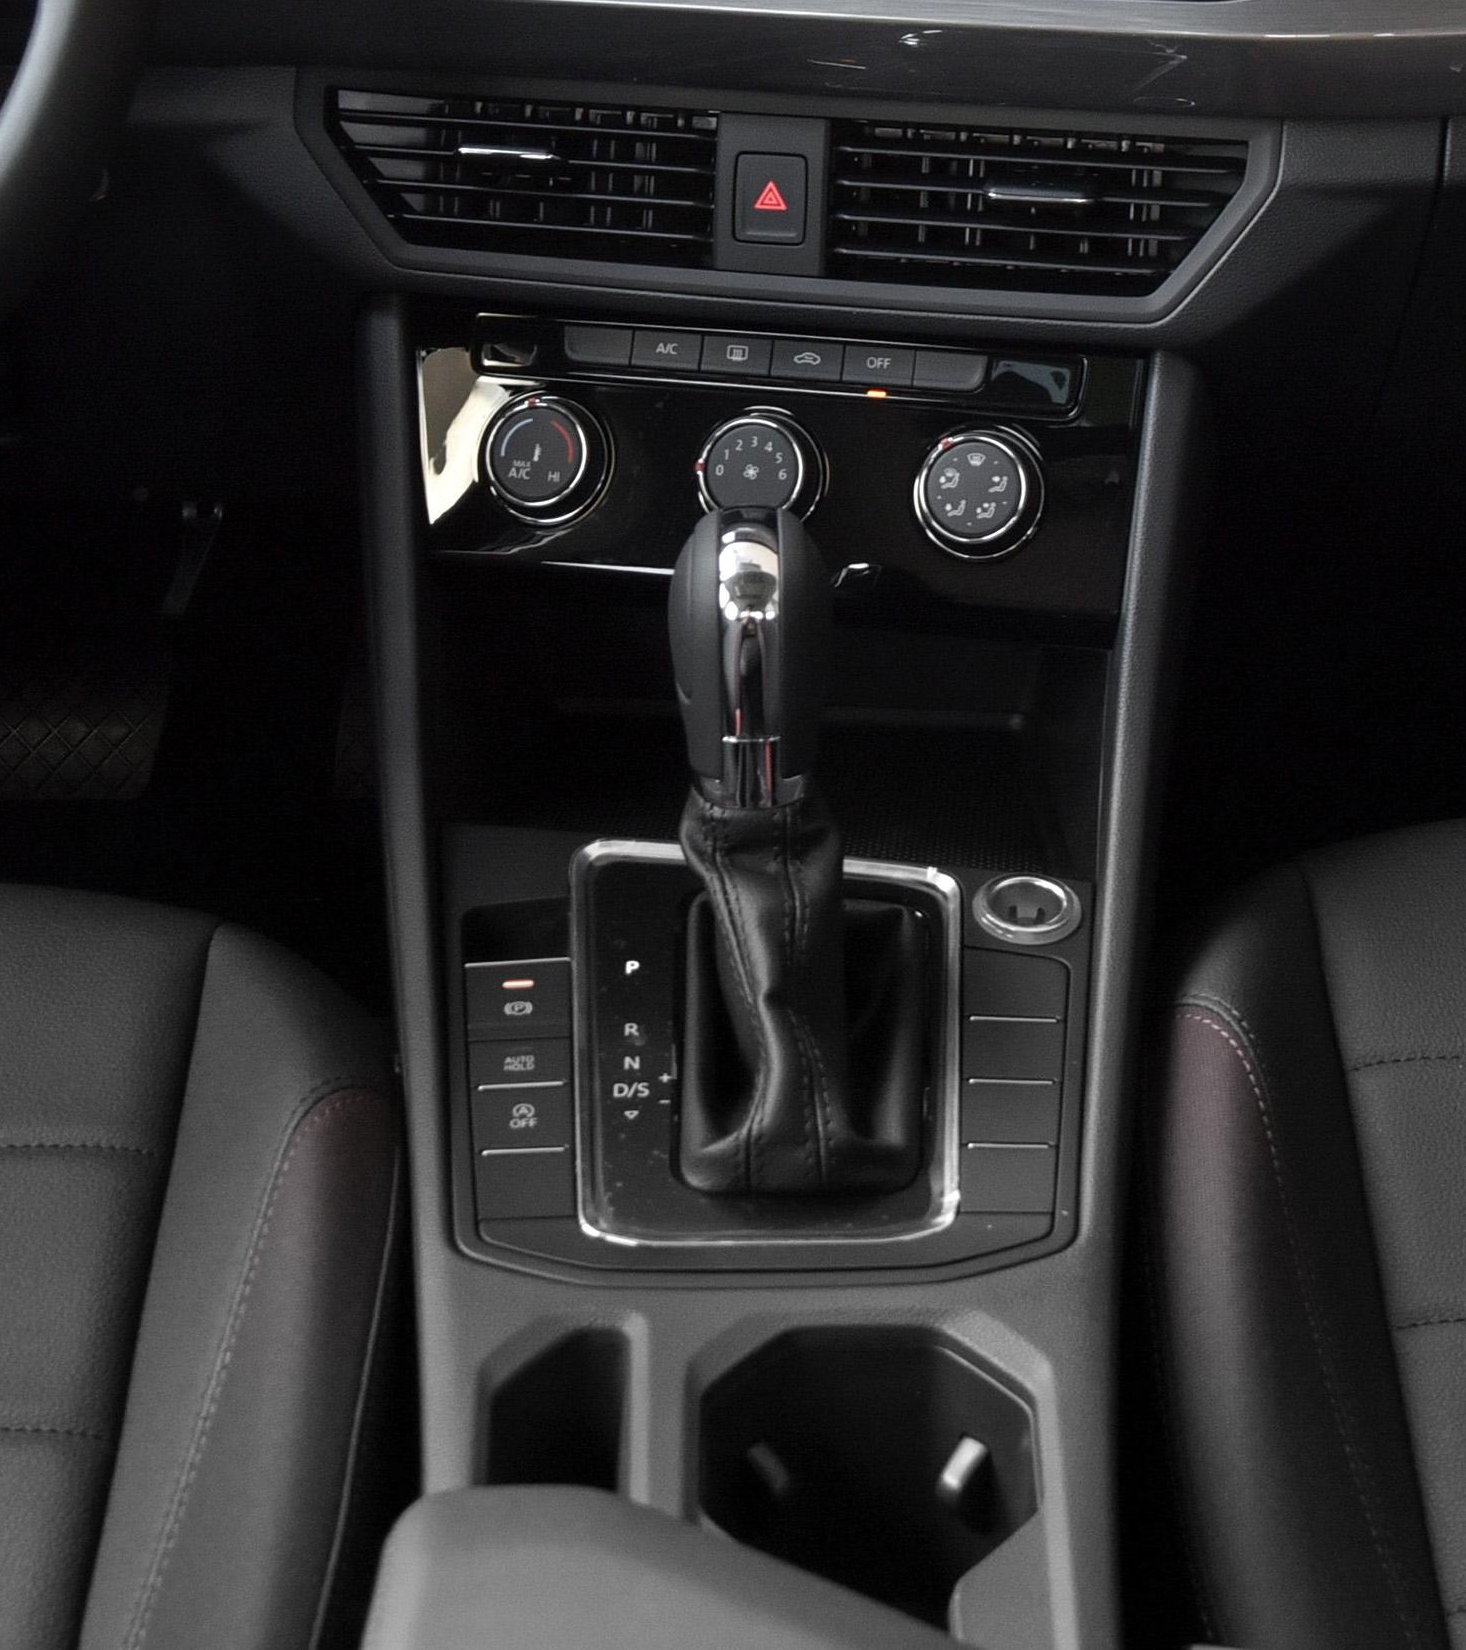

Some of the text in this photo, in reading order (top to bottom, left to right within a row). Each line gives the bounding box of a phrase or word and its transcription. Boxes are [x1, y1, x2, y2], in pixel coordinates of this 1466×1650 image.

[655, 342, 678, 355] A/C
[866, 356, 891, 369] OFF
[735, 439, 743, 451] 2
[751, 435, 758, 447] 3
[764, 441, 773, 452] 4
[724, 449, 730, 460] 1
[775, 452, 783, 464] 5
[507, 467, 532, 480] A/C
[715, 464, 725, 476] 0
[778, 468, 788, 480] 6
[625, 960, 640, 975] P
[624, 1022, 640, 1037] R
[504, 1055, 535, 1064] AUTO
[624, 1056, 640, 1070] N
[503, 1062, 535, 1071] HOLD
[612, 1082, 651, 1098] D/S
[509, 1117, 538, 1129] OFF
